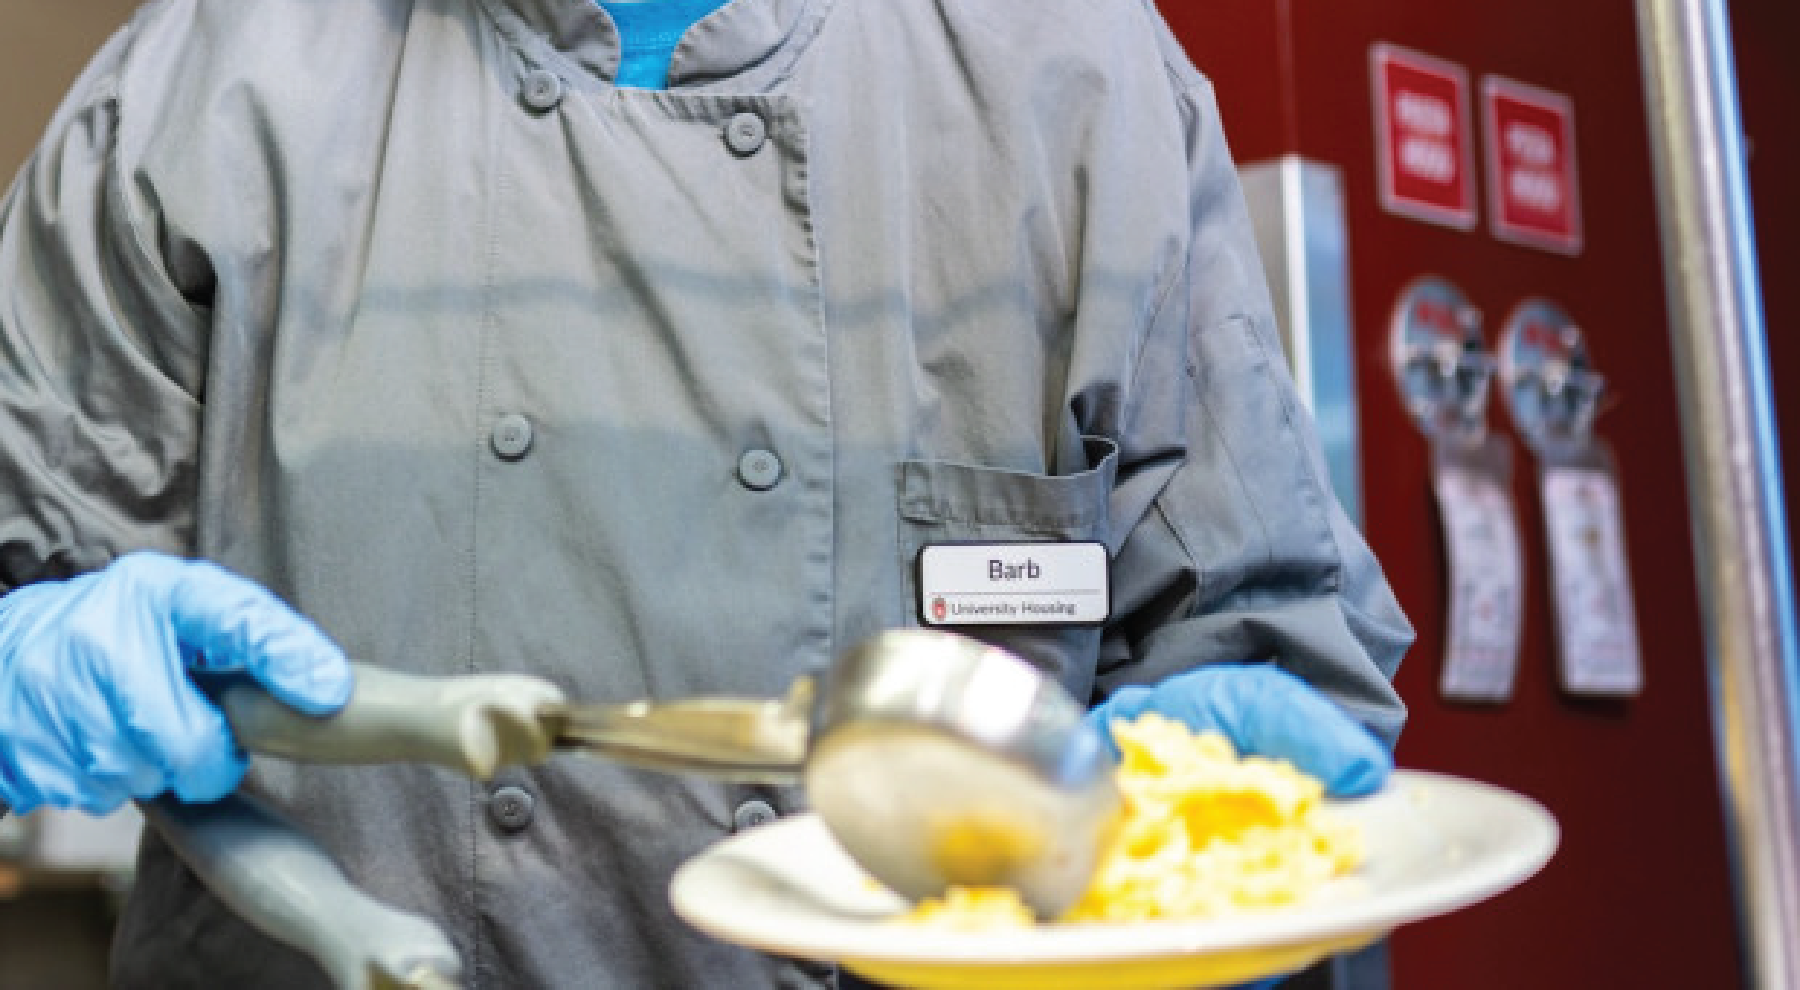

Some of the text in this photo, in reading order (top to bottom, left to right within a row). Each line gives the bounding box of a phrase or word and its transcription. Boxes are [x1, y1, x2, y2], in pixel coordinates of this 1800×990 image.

[987, 557, 1041, 580] Barb
[951, 601, 1077, 616] University Housing
